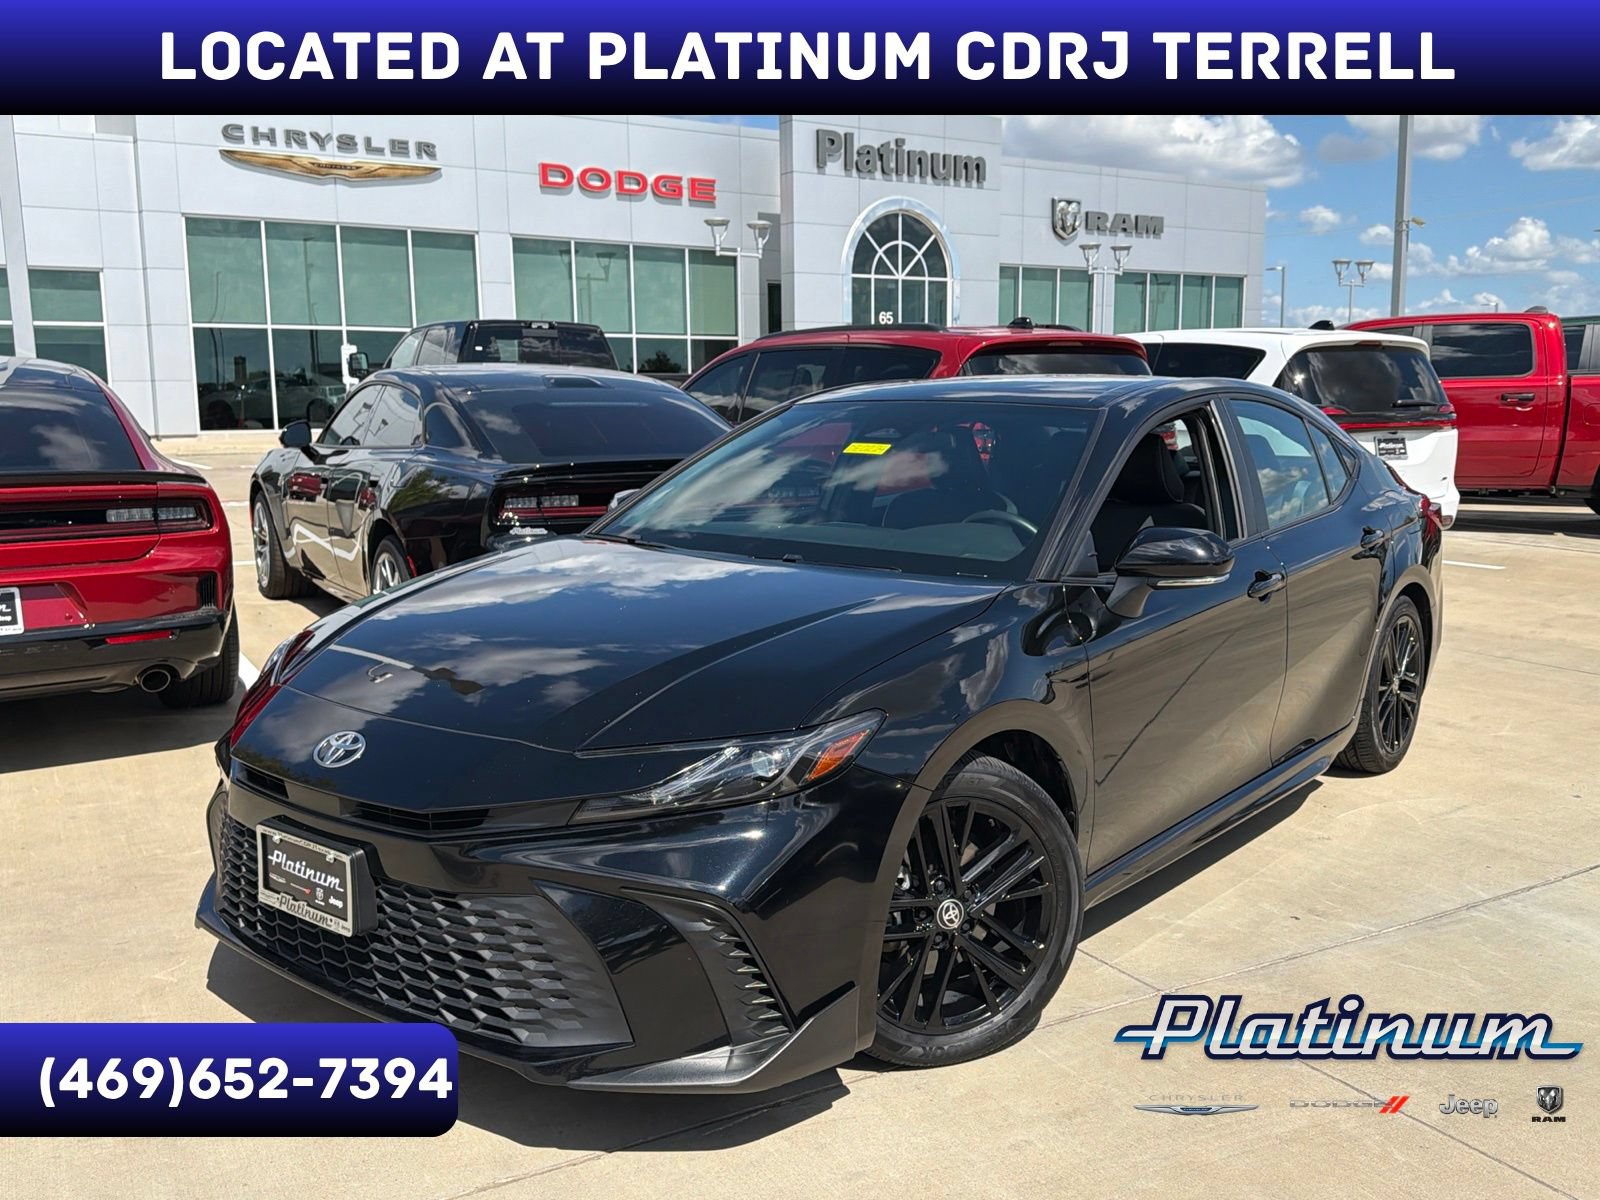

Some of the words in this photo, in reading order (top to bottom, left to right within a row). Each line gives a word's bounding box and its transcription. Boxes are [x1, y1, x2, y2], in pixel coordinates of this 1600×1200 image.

[221, 123, 438, 160] CHRYSLER
[816, 129, 987, 186] Platinum
[539, 162, 717, 204] DODGE
[1085, 211, 1164, 237] RAM
[878, 311, 894, 325] 65
[267, 849, 344, 892] Platinum
[279, 895, 334, 928] Platinum
